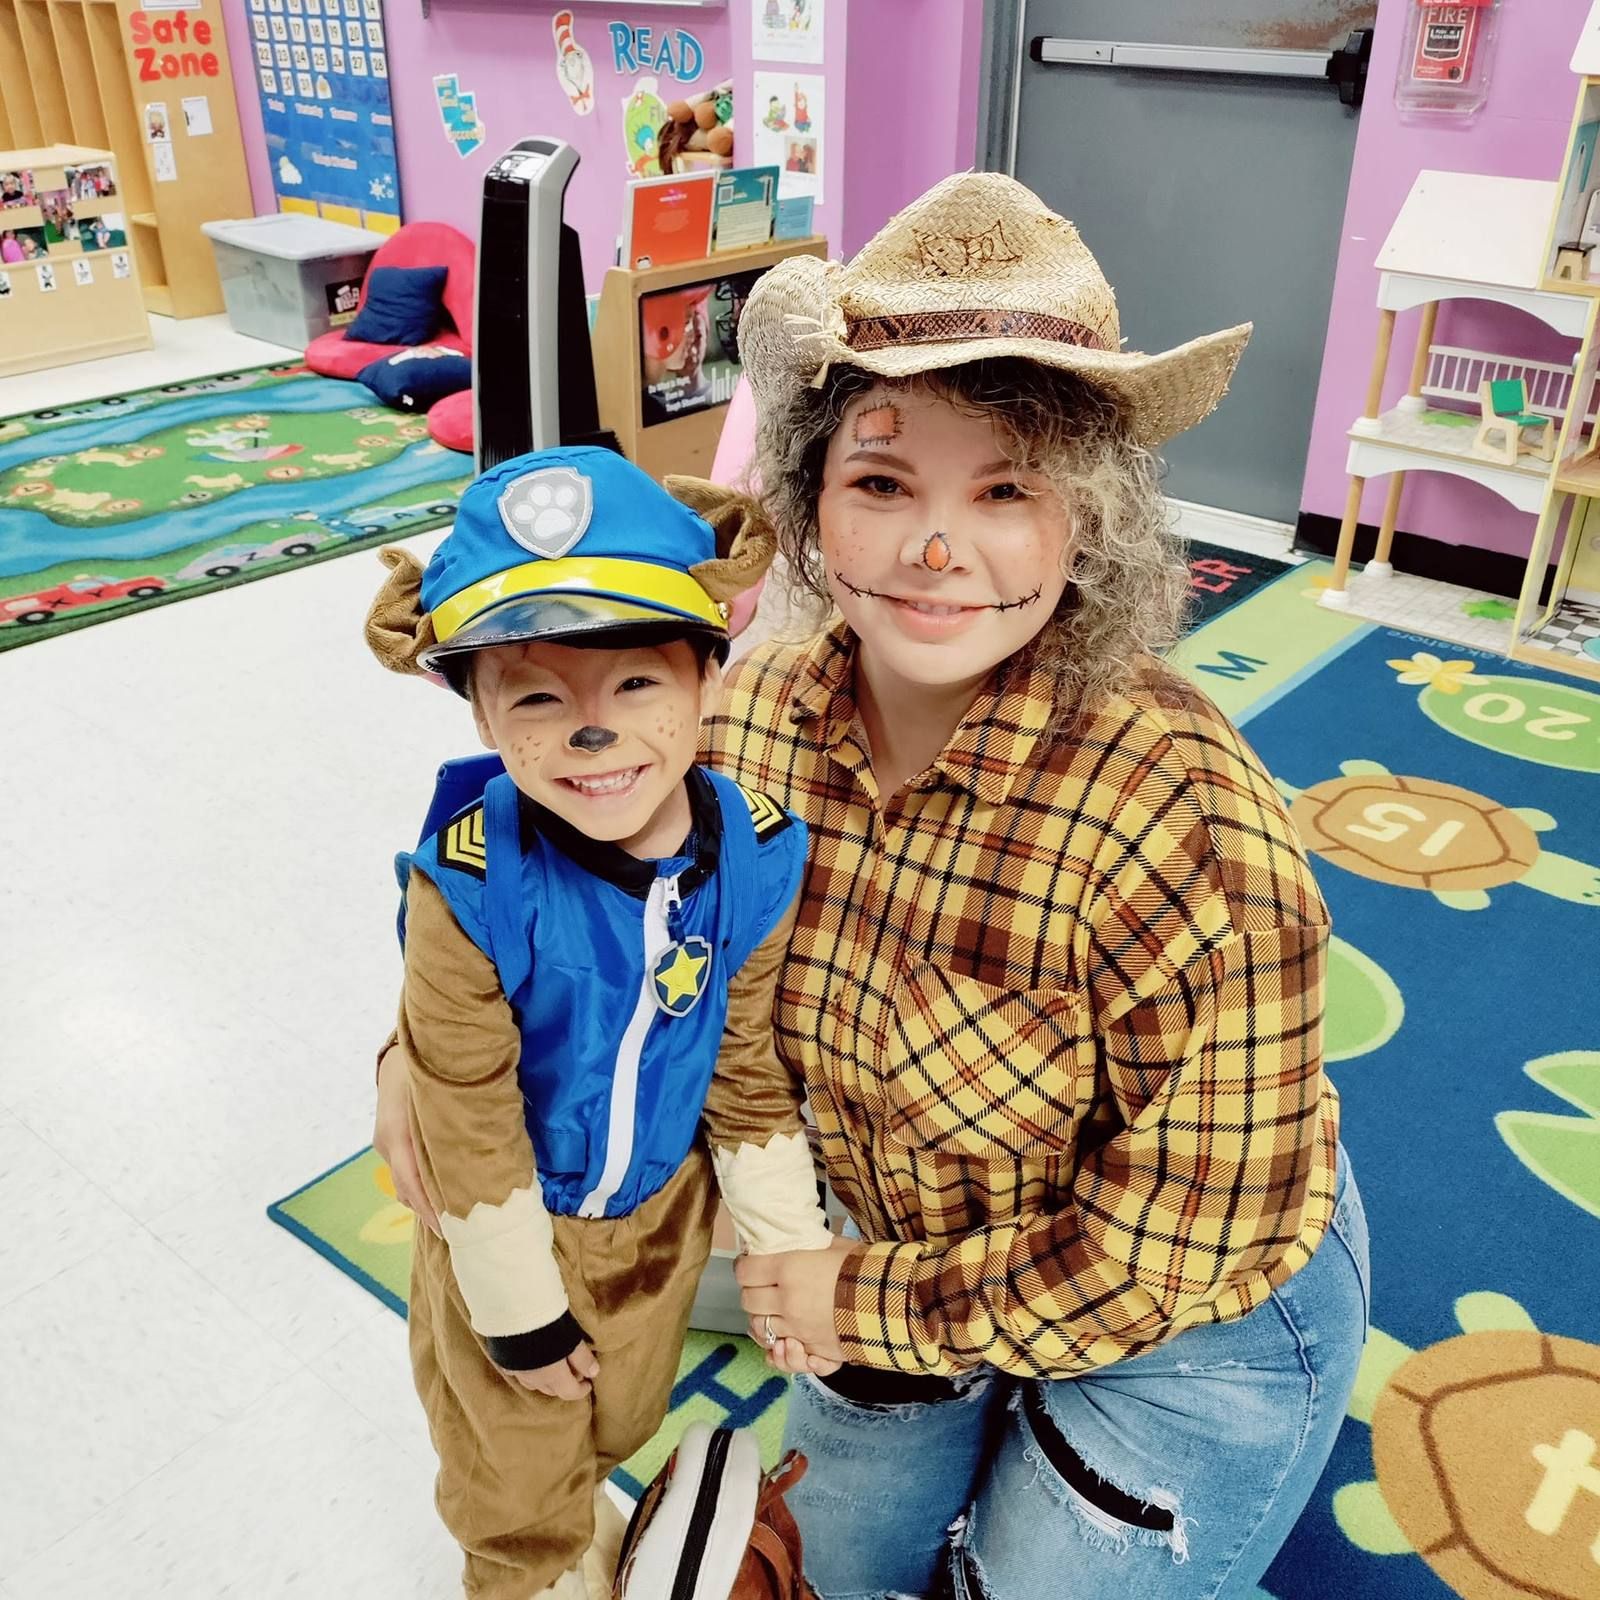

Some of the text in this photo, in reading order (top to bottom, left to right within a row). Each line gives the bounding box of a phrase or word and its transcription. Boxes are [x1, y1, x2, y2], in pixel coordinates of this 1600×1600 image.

[129, 10, 212, 45] Safe
[290, 23, 301, 36] 17
[1427, 6, 1469, 24] FIRE
[134, 47, 219, 82] Zone
[608, 21, 704, 83] READ
[1183, 558, 1254, 597] ER
[48, 596, 71, 610] X
[1463, 693, 1591, 740] 20
[1345, 802, 1465, 857] 15
